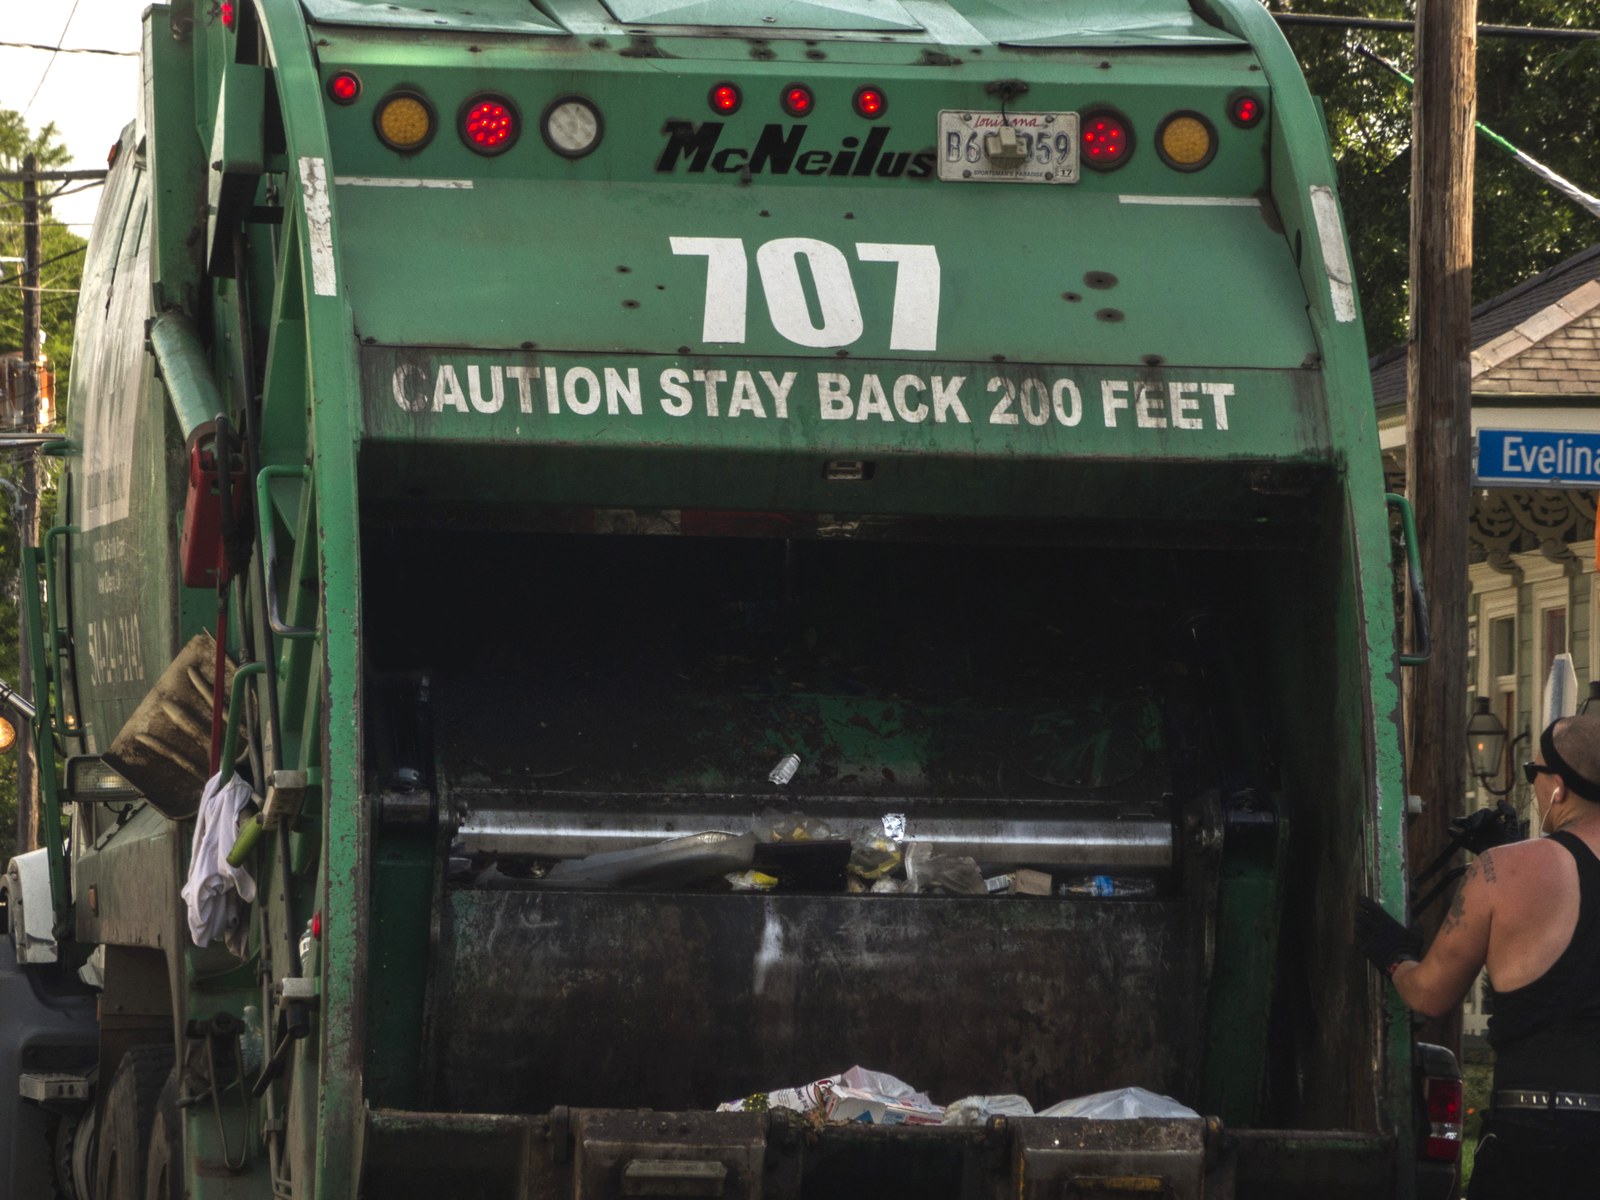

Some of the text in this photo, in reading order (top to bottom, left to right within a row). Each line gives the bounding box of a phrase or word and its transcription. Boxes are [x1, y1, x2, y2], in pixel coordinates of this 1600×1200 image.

[656, 121, 937, 178] McNeilus
[974, 115, 1038, 128] Louiana
[669, 236, 940, 351] 707
[392, 364, 1235, 431] CAUTION STAY BACK 200 FEET
[1520, 1095, 1586, 1106] LIVING
